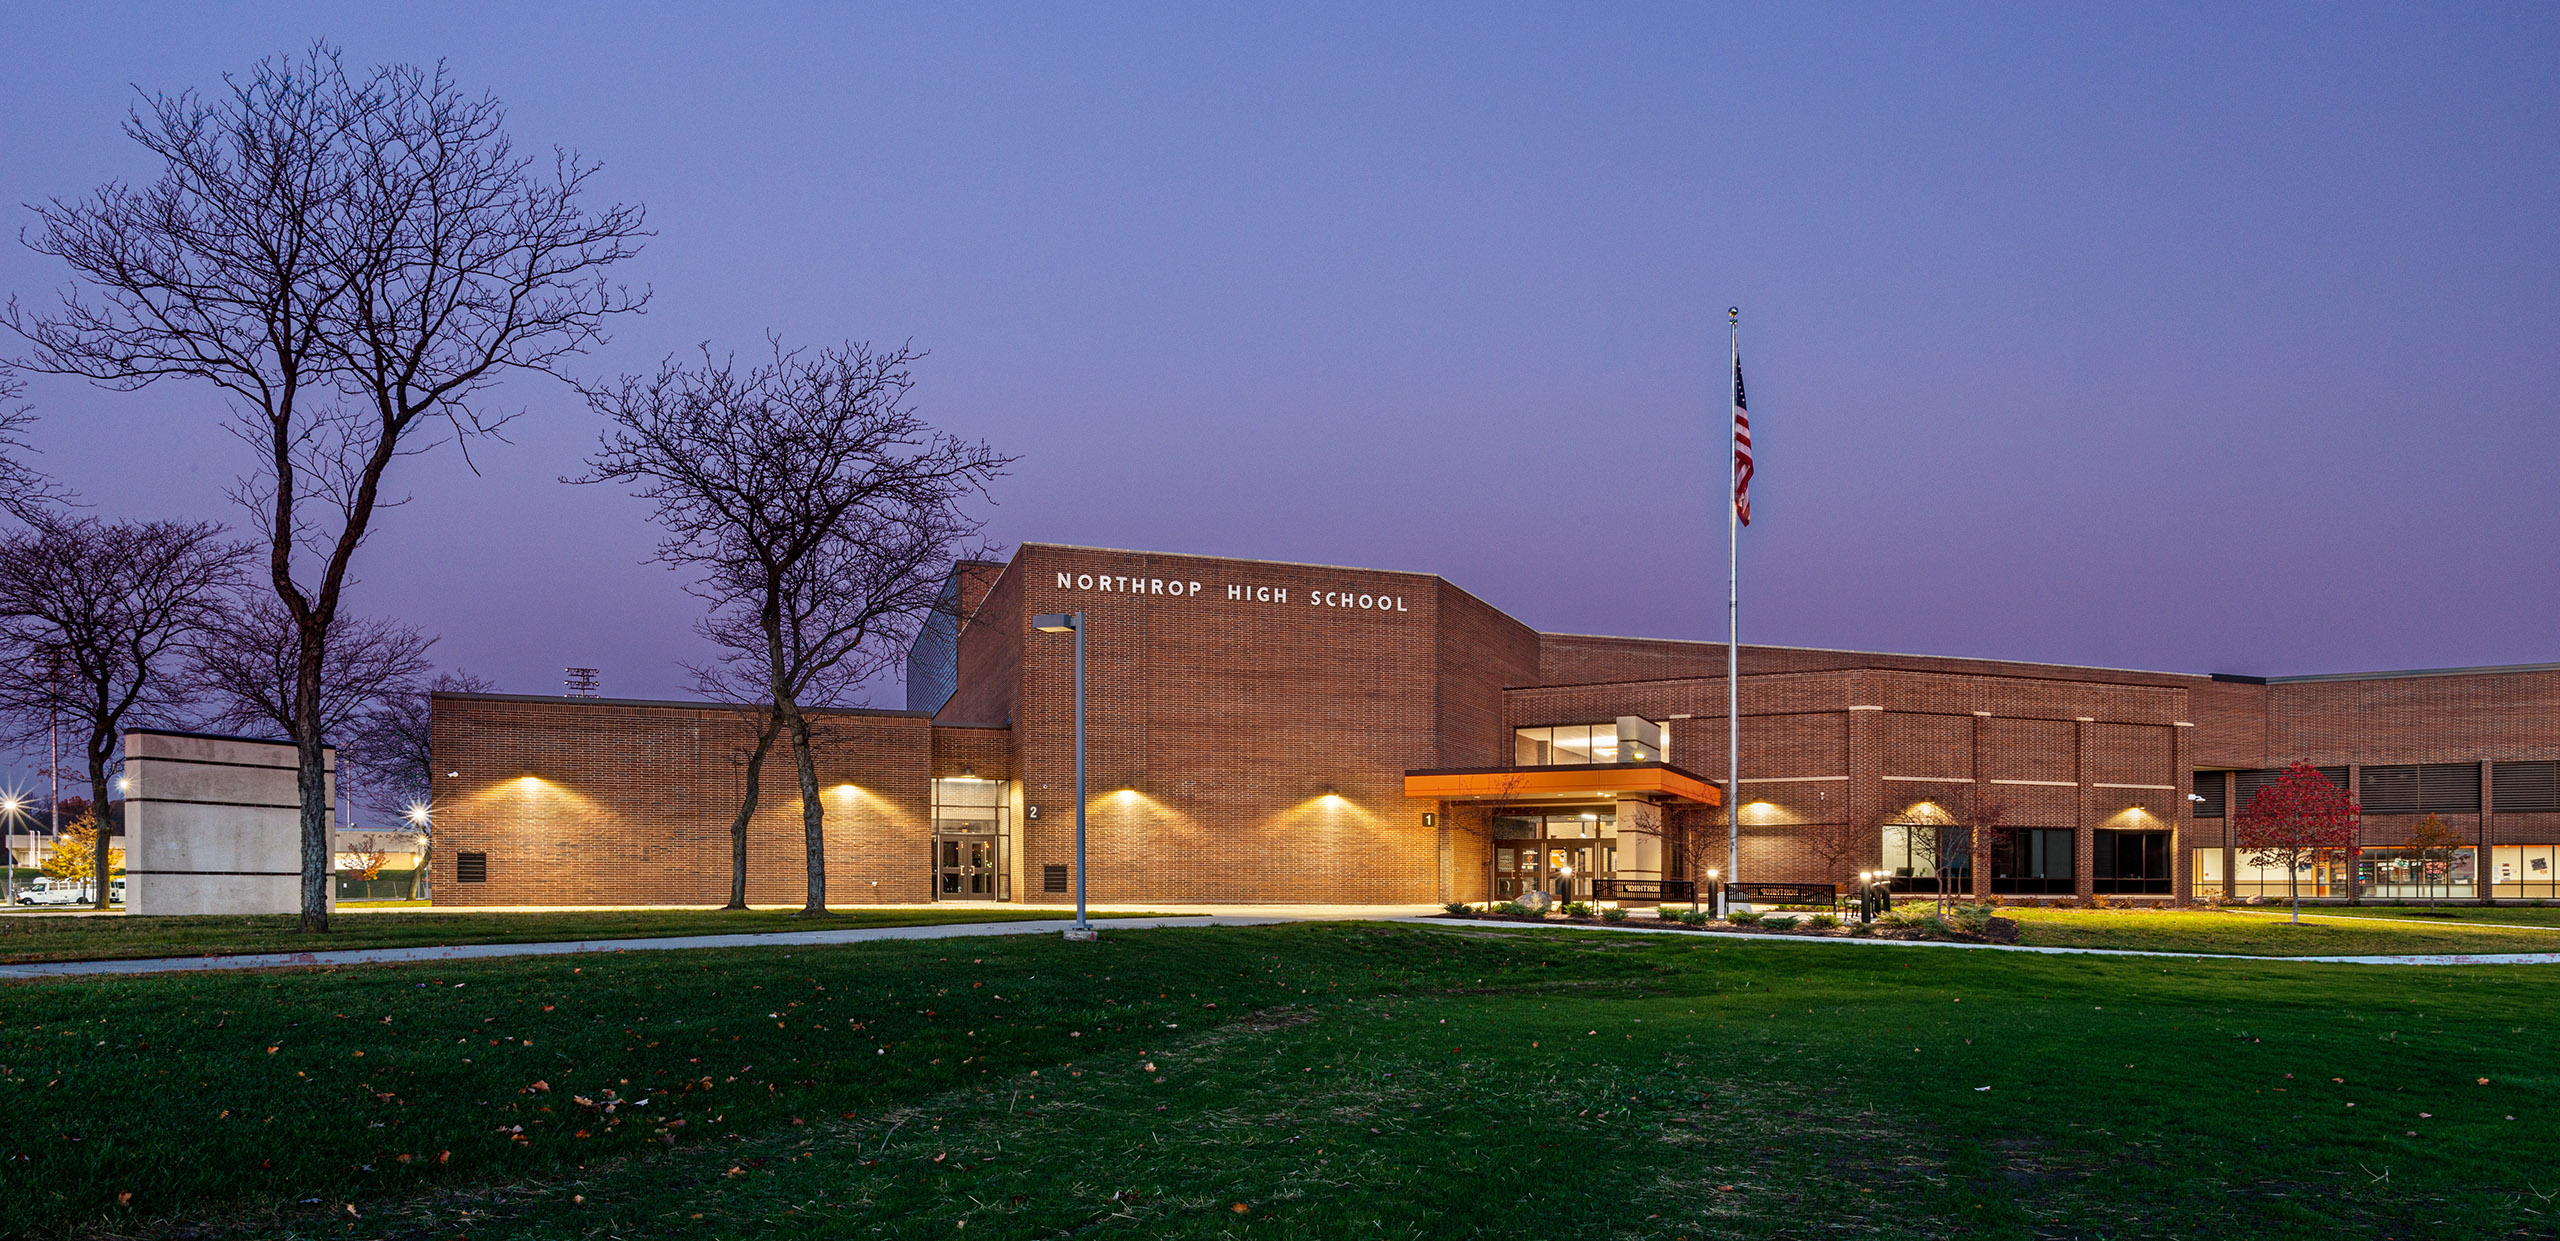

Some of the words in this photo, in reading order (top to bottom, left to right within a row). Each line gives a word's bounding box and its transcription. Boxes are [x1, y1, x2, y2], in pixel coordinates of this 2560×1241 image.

[1057, 572, 1202, 597] NORTHROP
[1228, 584, 1287, 604] HIGH
[1310, 590, 1408, 612] SCHOOL
[1030, 806, 1037, 818] 2
[1425, 814, 1431, 826] 1
